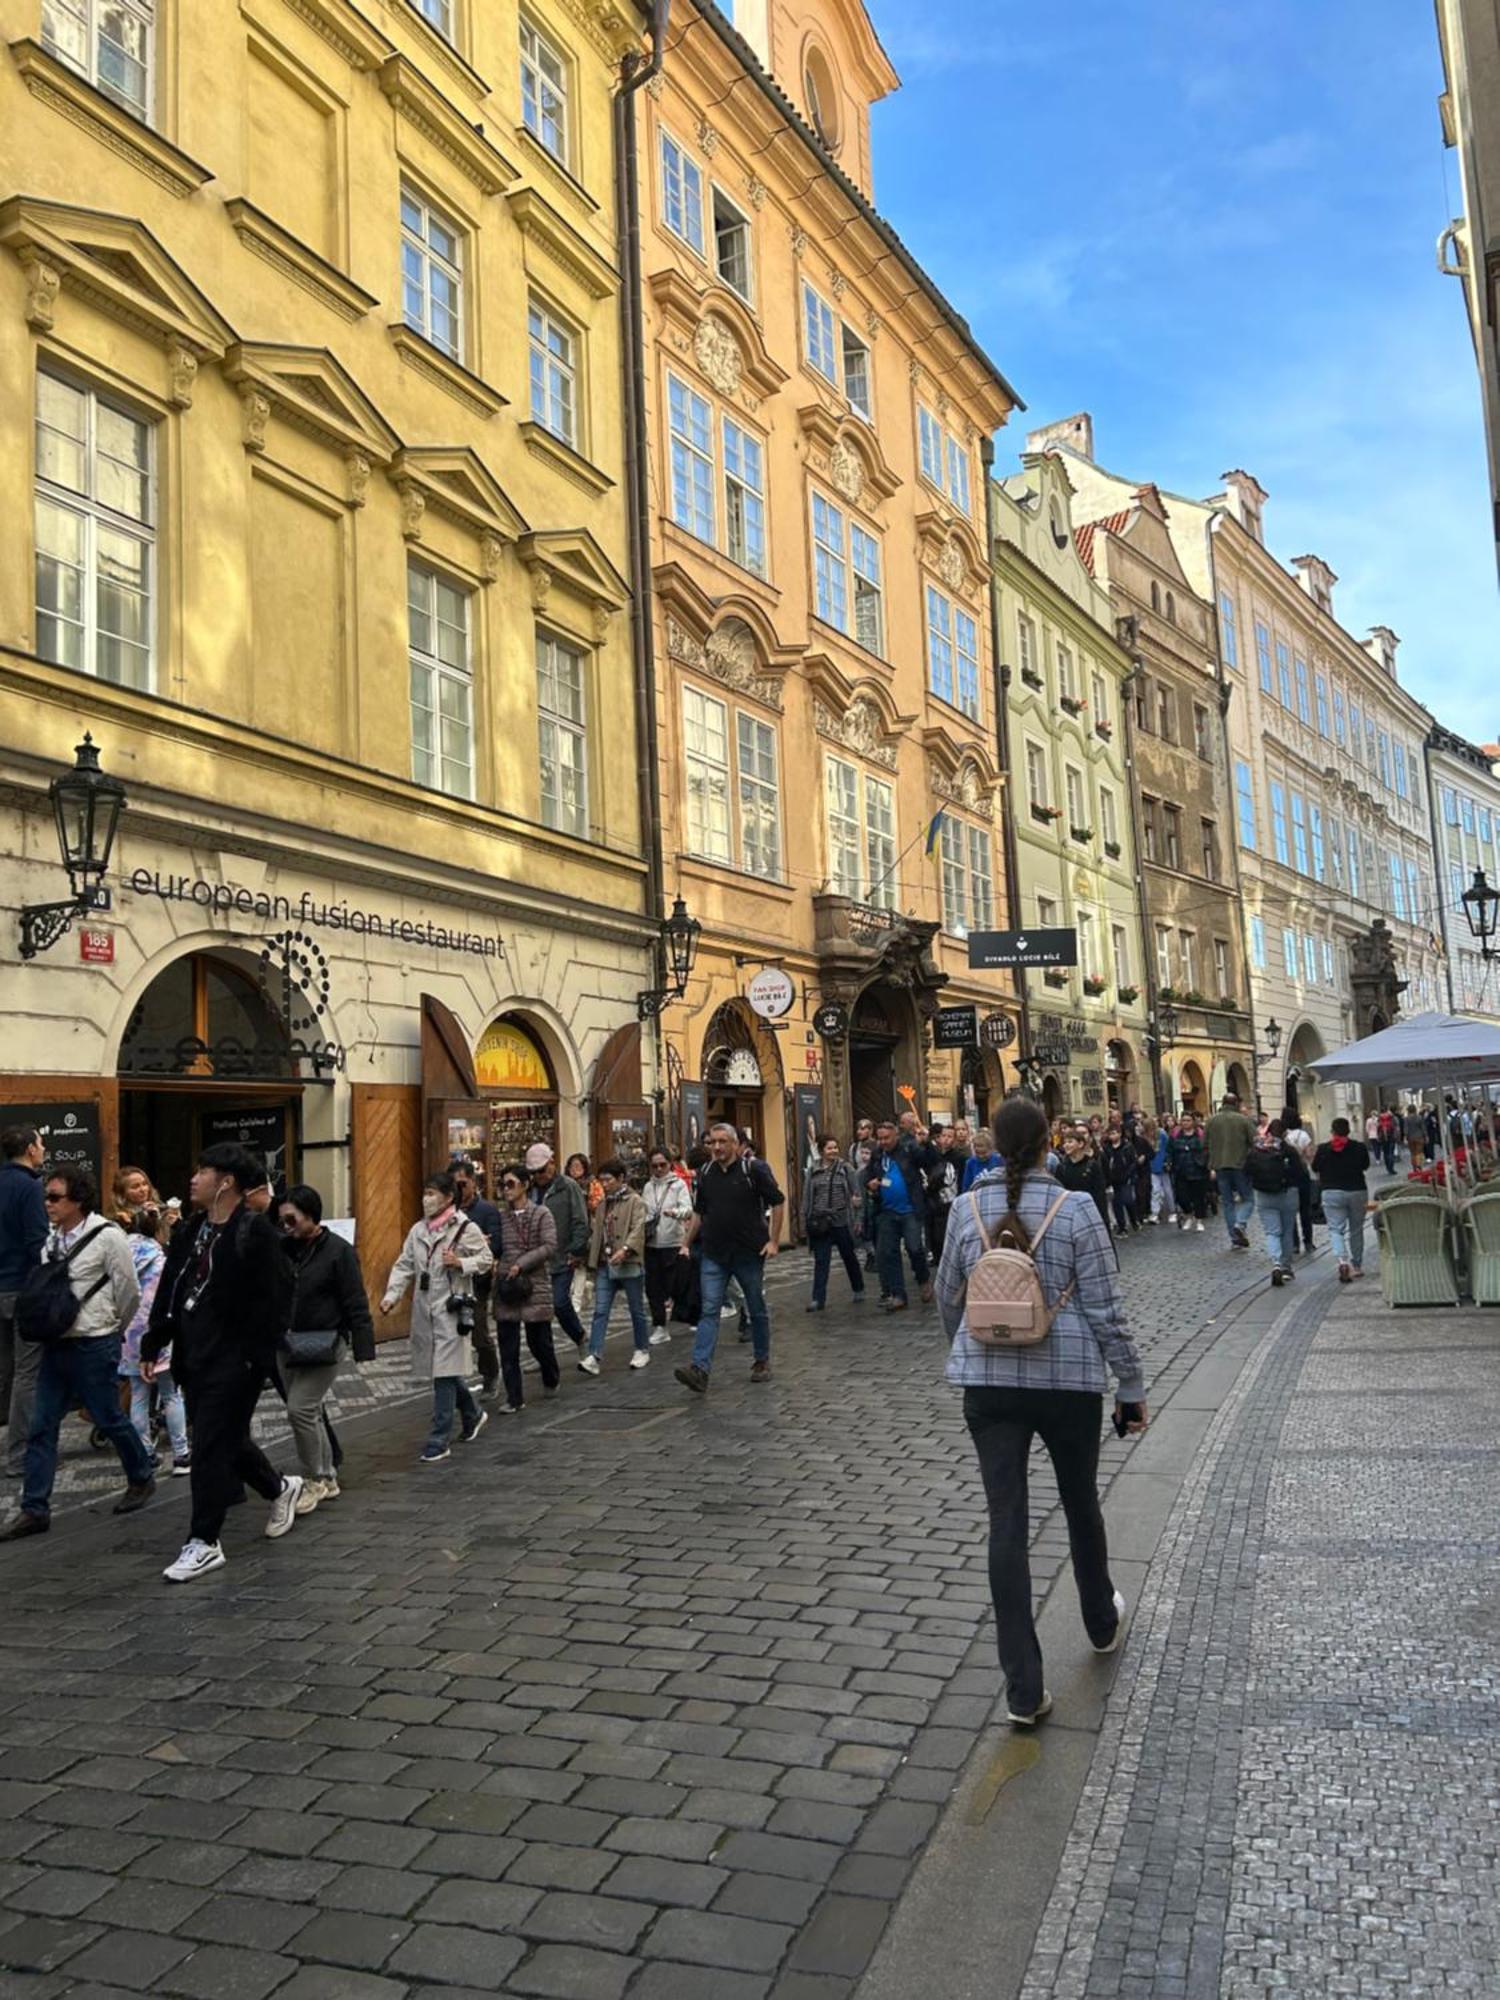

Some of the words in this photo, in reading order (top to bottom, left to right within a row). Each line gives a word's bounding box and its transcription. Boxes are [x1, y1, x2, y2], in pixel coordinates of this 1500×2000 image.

[132, 868, 290, 921] european
[299, 892, 383, 936] fusion
[390, 917, 505, 960] restaurant
[88, 932, 108, 947] 185
[941, 1029, 972, 1038] MUSEUM
[55, 1149, 87, 1161] SOUP
